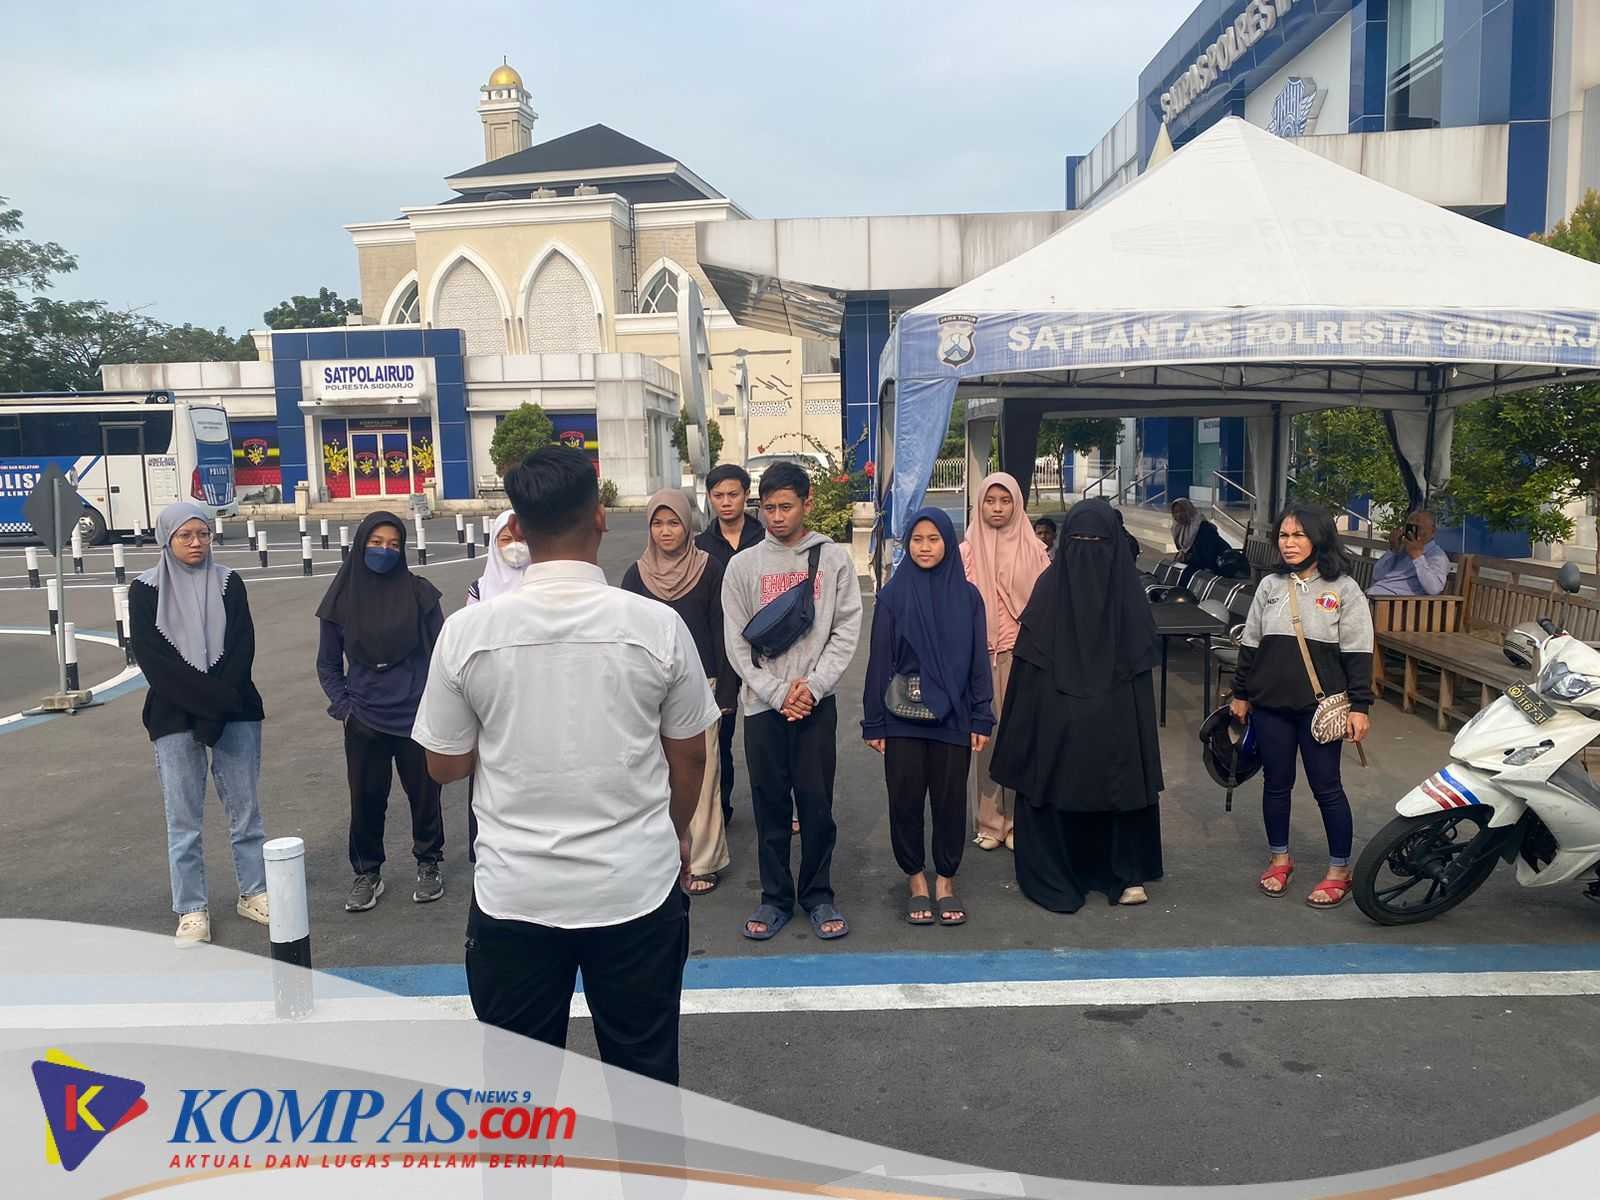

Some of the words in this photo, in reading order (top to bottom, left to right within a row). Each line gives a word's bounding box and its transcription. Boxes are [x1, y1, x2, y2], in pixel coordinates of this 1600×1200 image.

[1008, 323, 1233, 352] SATLANTAS
[1246, 321, 1431, 345] POLRESTA
[1443, 320, 1600, 348] SIDOARJ
[324, 364, 415, 384] SATPOLAIRUD
[325, 383, 370, 391] POLRESTA
[370, 382, 415, 390] SIDOARJO
